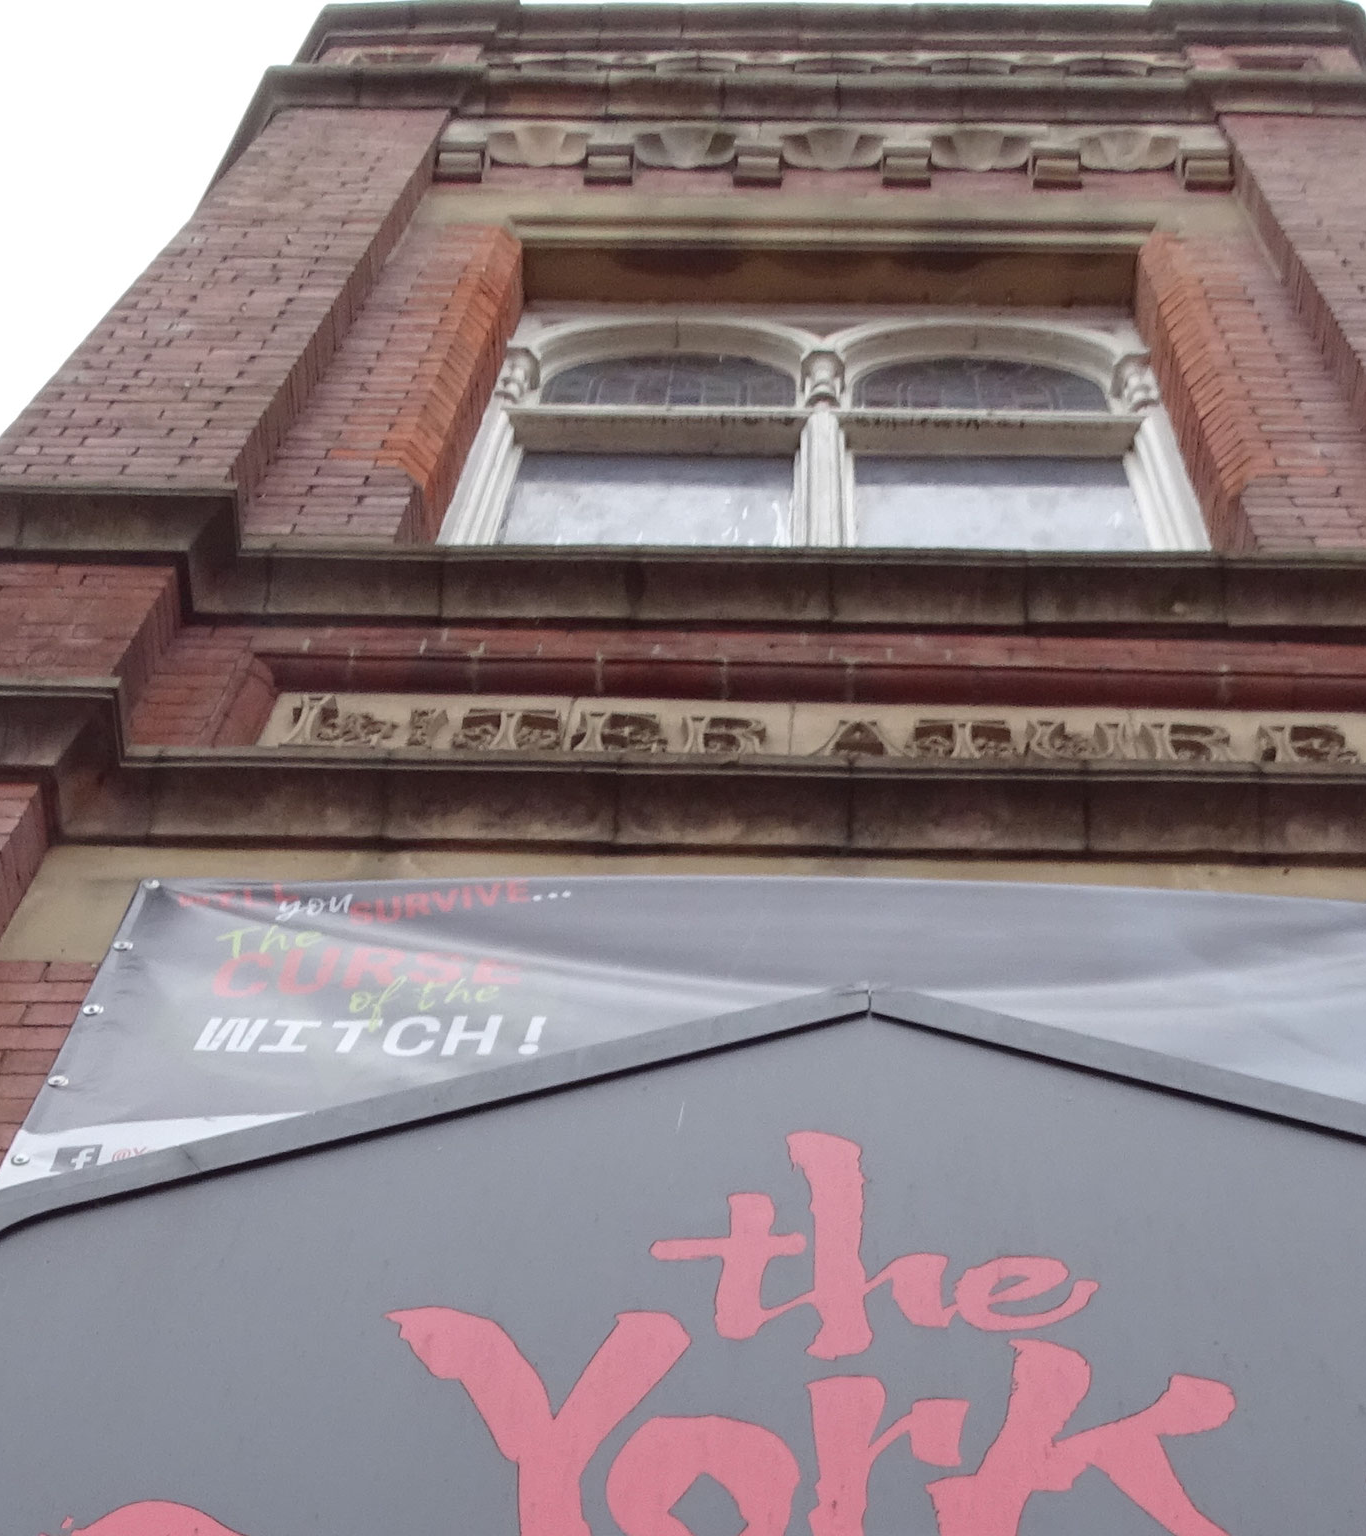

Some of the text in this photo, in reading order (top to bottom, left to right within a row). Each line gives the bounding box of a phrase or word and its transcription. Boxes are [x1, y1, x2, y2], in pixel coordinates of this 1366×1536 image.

[275, 892, 354, 922] you
[217, 925, 323, 959] The
[212, 946, 524, 998] CURSE
[348, 975, 501, 1034] of the
[192, 1014, 548, 1057] WITCH!
[651, 1132, 1098, 1359] the
